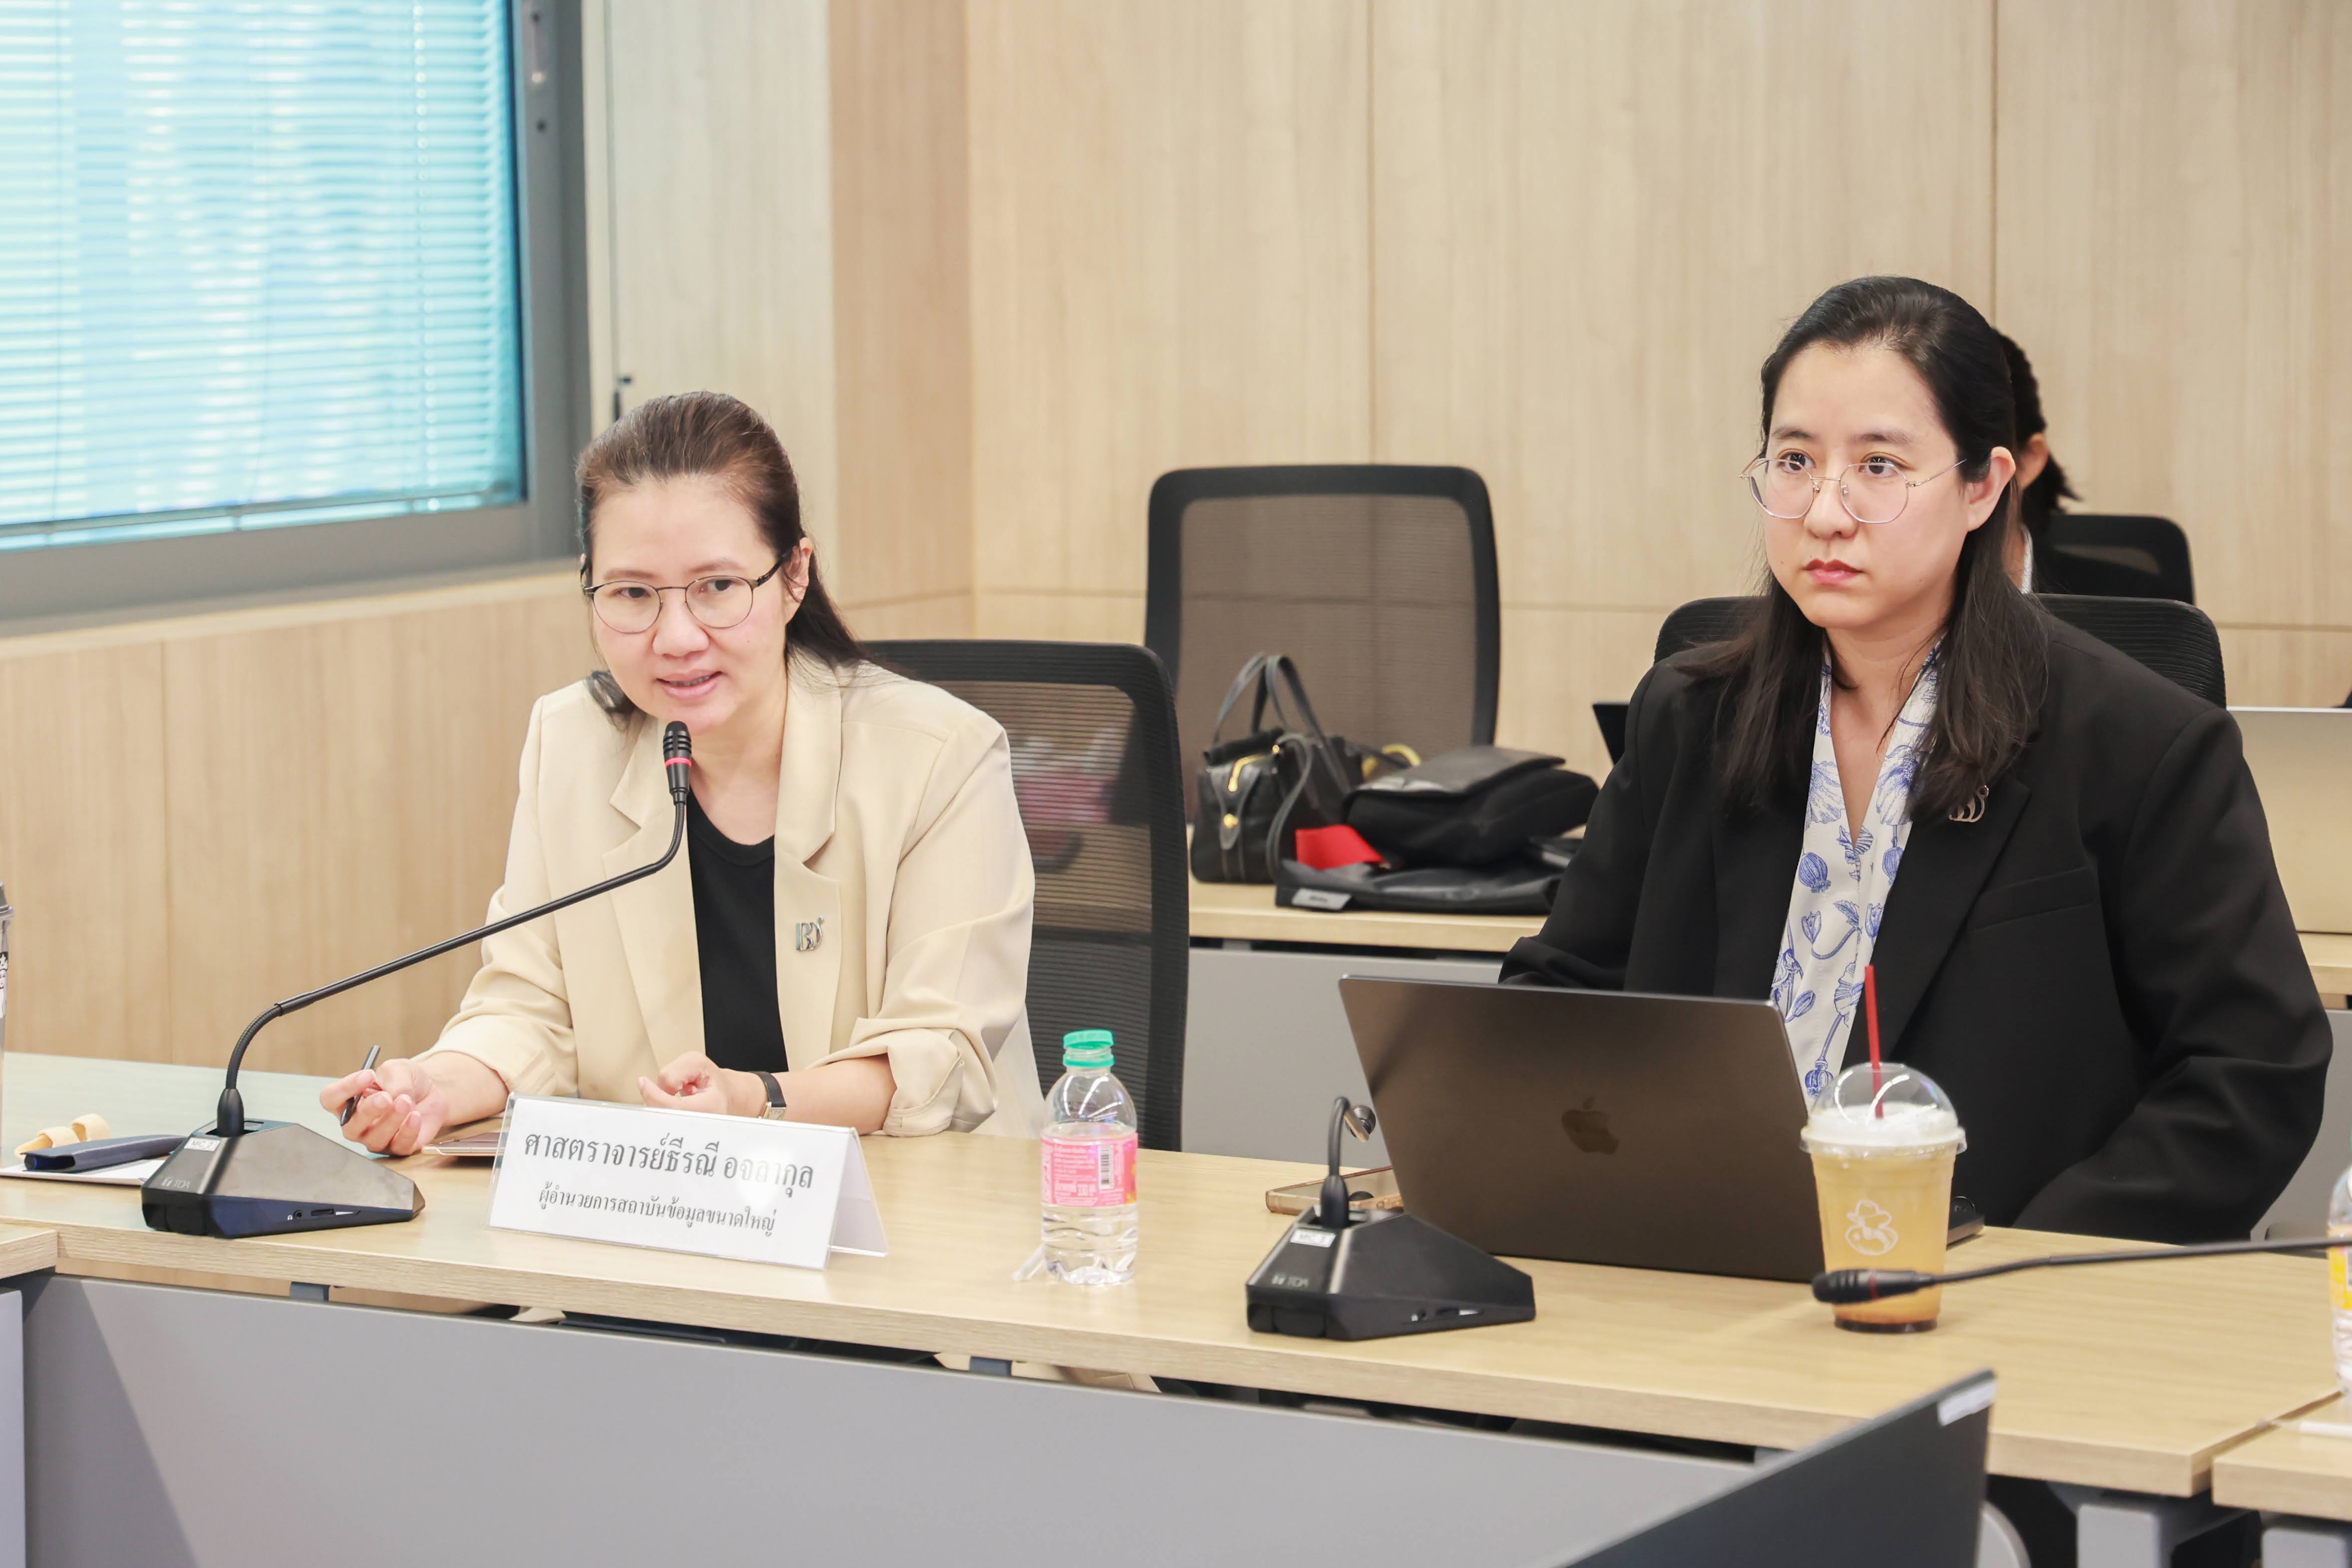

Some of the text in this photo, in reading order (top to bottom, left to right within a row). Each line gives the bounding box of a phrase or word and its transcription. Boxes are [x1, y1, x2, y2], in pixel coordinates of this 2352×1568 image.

[525, 1133, 719, 1177] ศาสตราจารย์ธีรณี
[539, 1181, 776, 1237] ผู้อำนวยการสถาบันข้อมูลขนาดใหญ่
